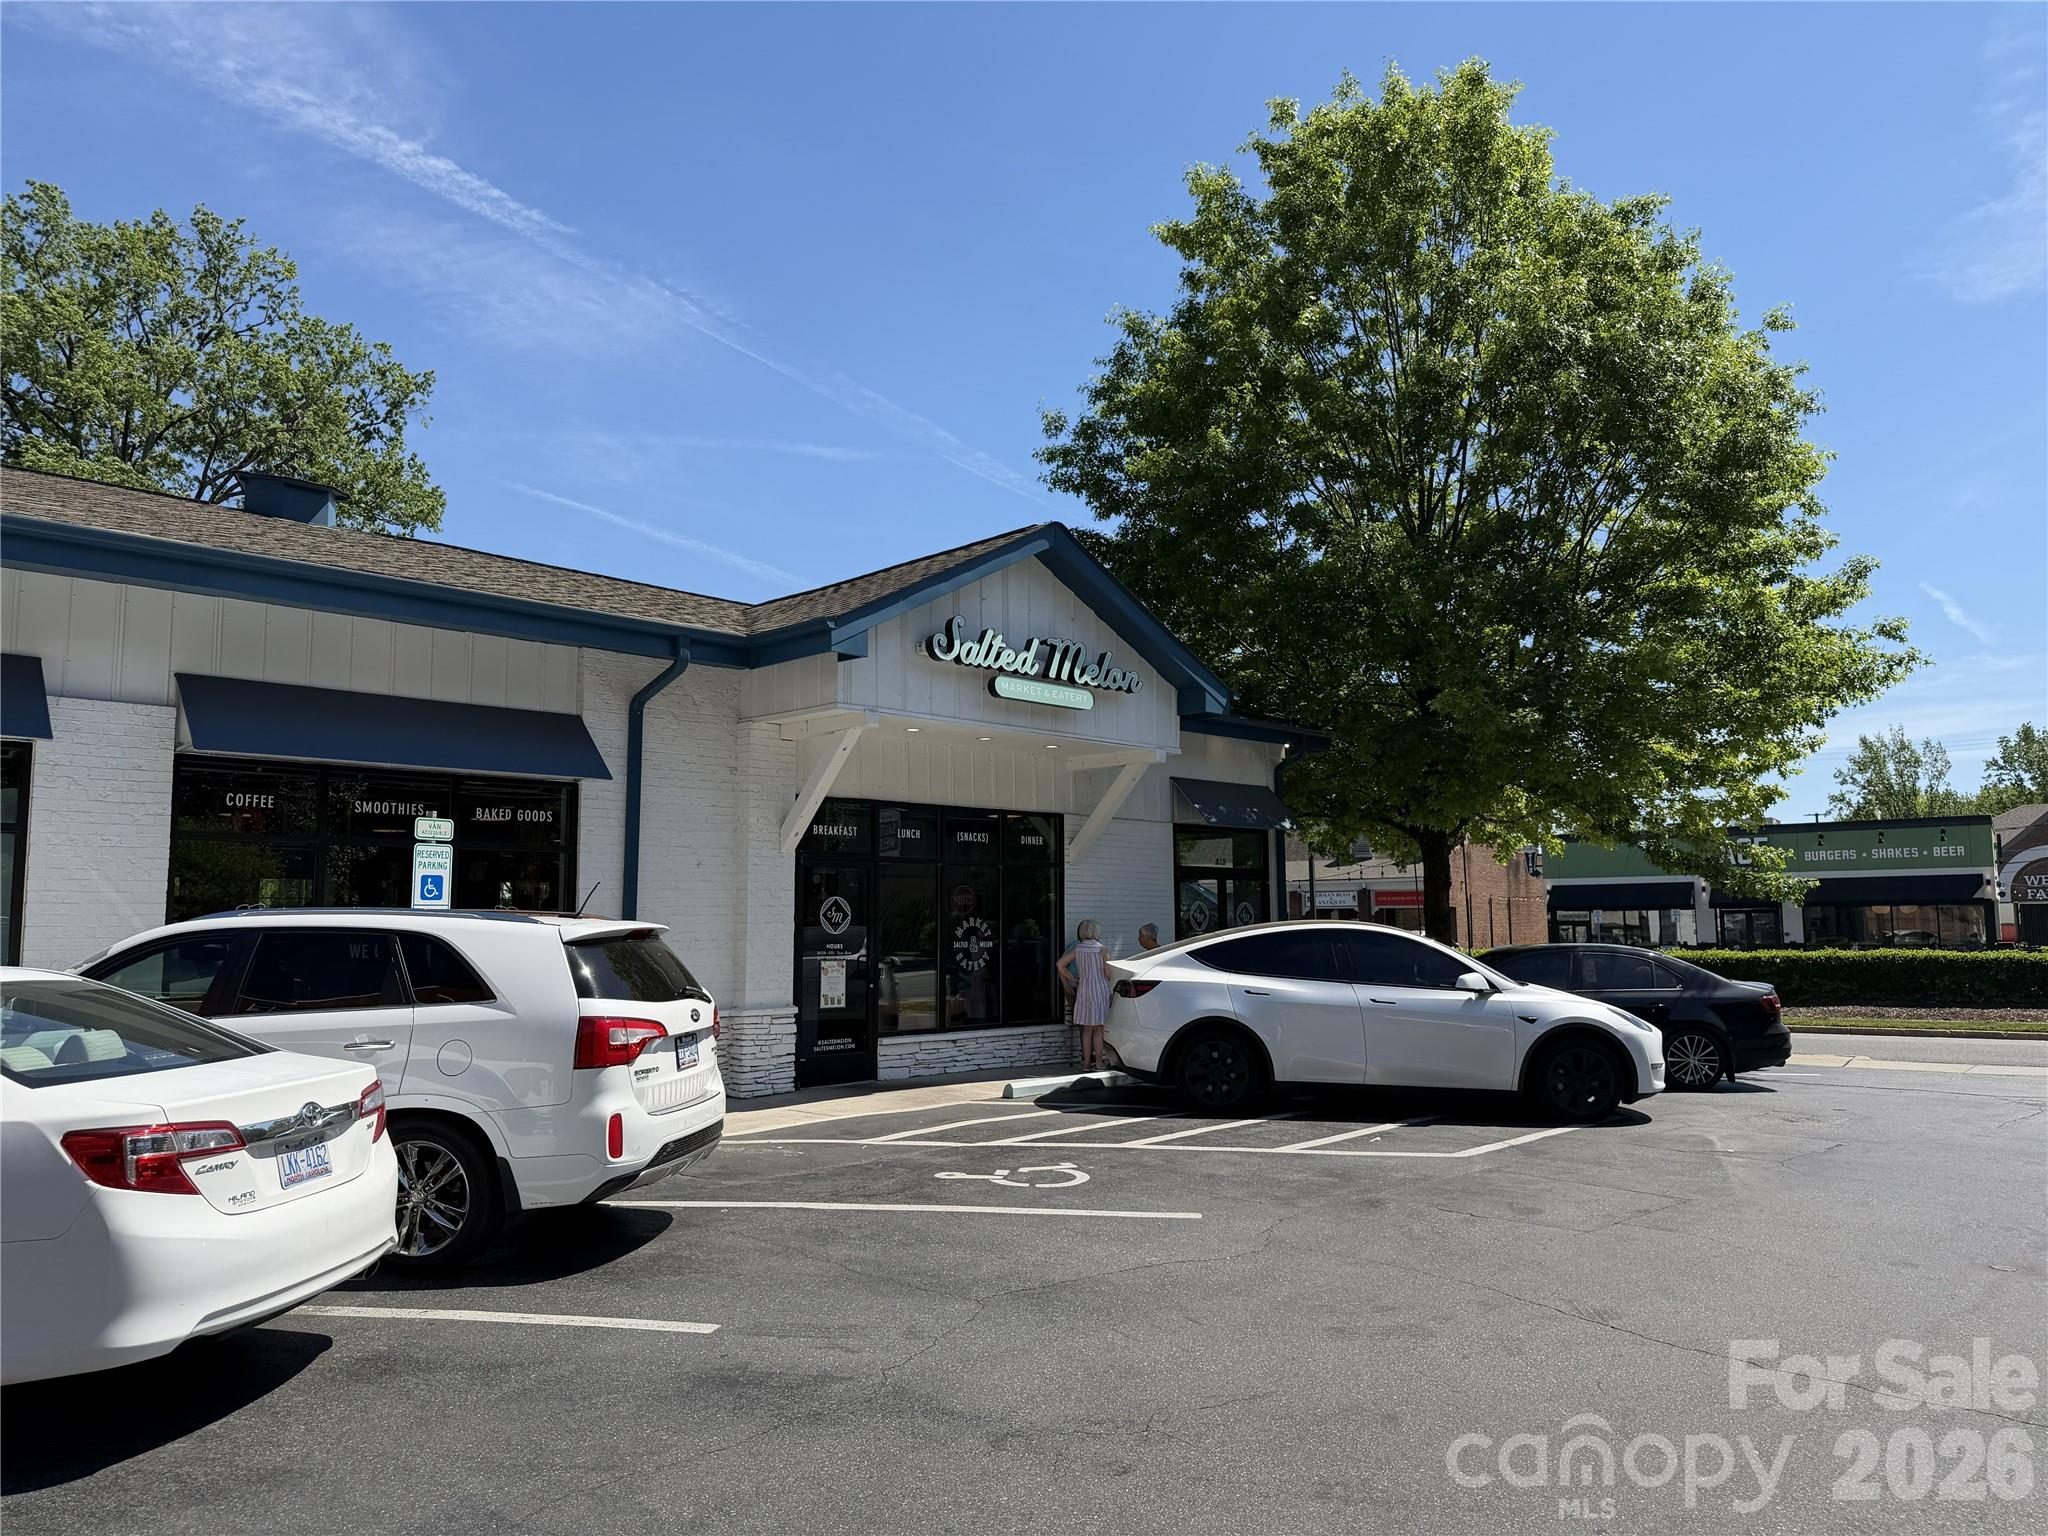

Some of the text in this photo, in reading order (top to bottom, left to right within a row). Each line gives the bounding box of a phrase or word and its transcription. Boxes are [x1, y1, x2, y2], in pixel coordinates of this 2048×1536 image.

[932, 614, 1144, 694] Salted Melon
[1001, 682, 1088, 703] MARKET & EATERY
[226, 792, 275, 809] COFFEE
[354, 800, 424, 816] SMOOTHIES
[475, 807, 553, 823] BAKED GOODS
[812, 824, 858, 837] BREAKFAST
[897, 828, 921, 839] LUNCH
[957, 831, 989, 843] (SNACKS)
[1020, 835, 1044, 846] DINNER
[417, 849, 450, 860] RESERVED
[1804, 845, 1965, 862] BURGERS SHAKES BEER
[418, 861, 448, 870] PARKING
[281, 1143, 329, 1177] LKK-4162
